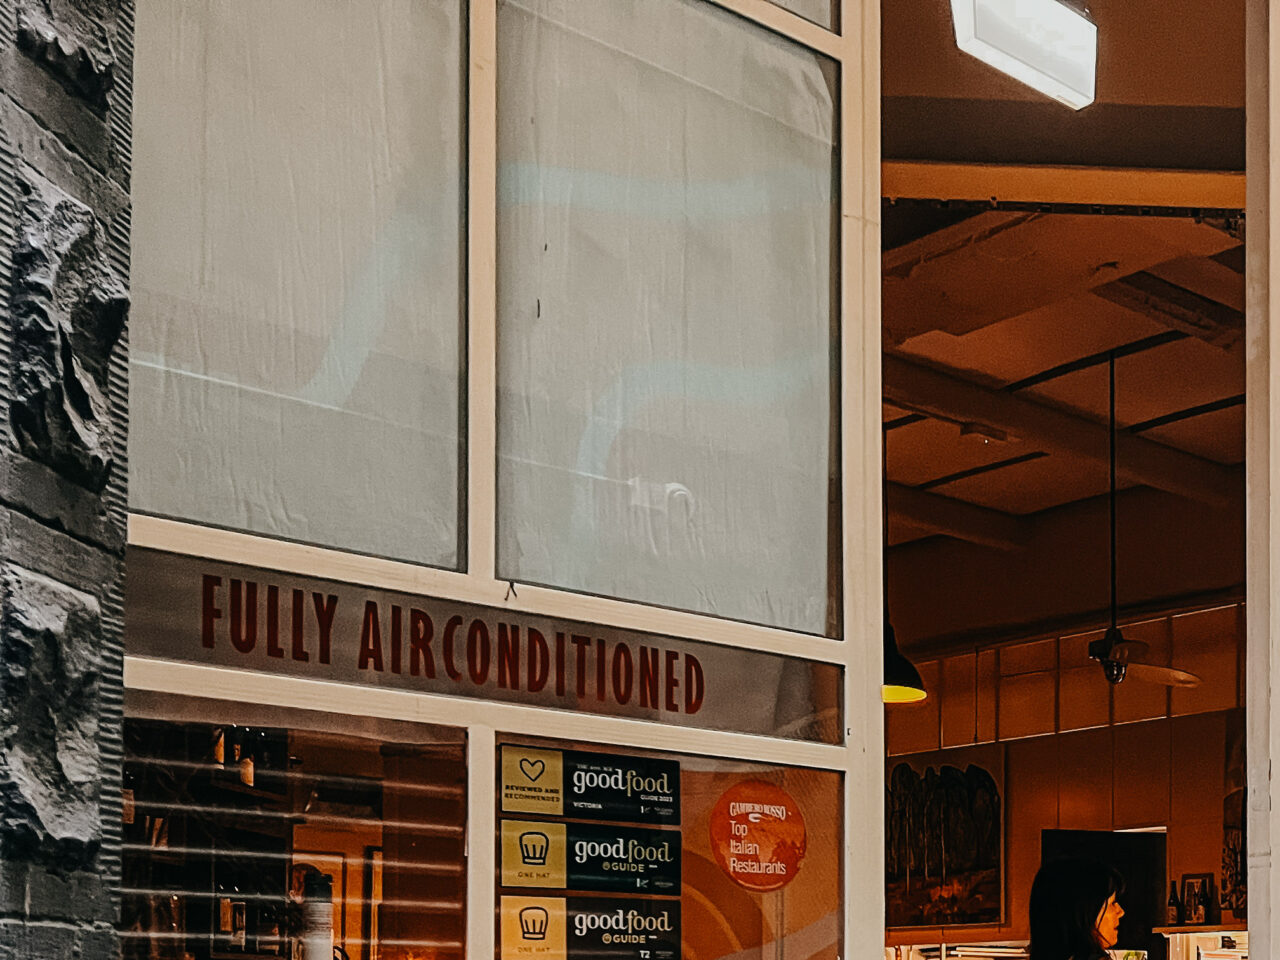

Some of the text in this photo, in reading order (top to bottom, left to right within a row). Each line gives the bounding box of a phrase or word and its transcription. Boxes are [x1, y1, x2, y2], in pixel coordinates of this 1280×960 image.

[201, 573, 705, 715] FULLY AIRCONDITIONED
[505, 784, 543, 792] REVIEWED
[504, 793, 561, 802] RECOMMENDED
[573, 801, 603, 809] VICTORIA
[729, 820, 748, 839] Top
[730, 839, 760, 855] Italian
[611, 862, 645, 873] GUIDE
[730, 857, 787, 875] Restaurants
[517, 871, 534, 879] ONE
[612, 935, 647, 944] GUIDE
[517, 946, 533, 954] ONE
